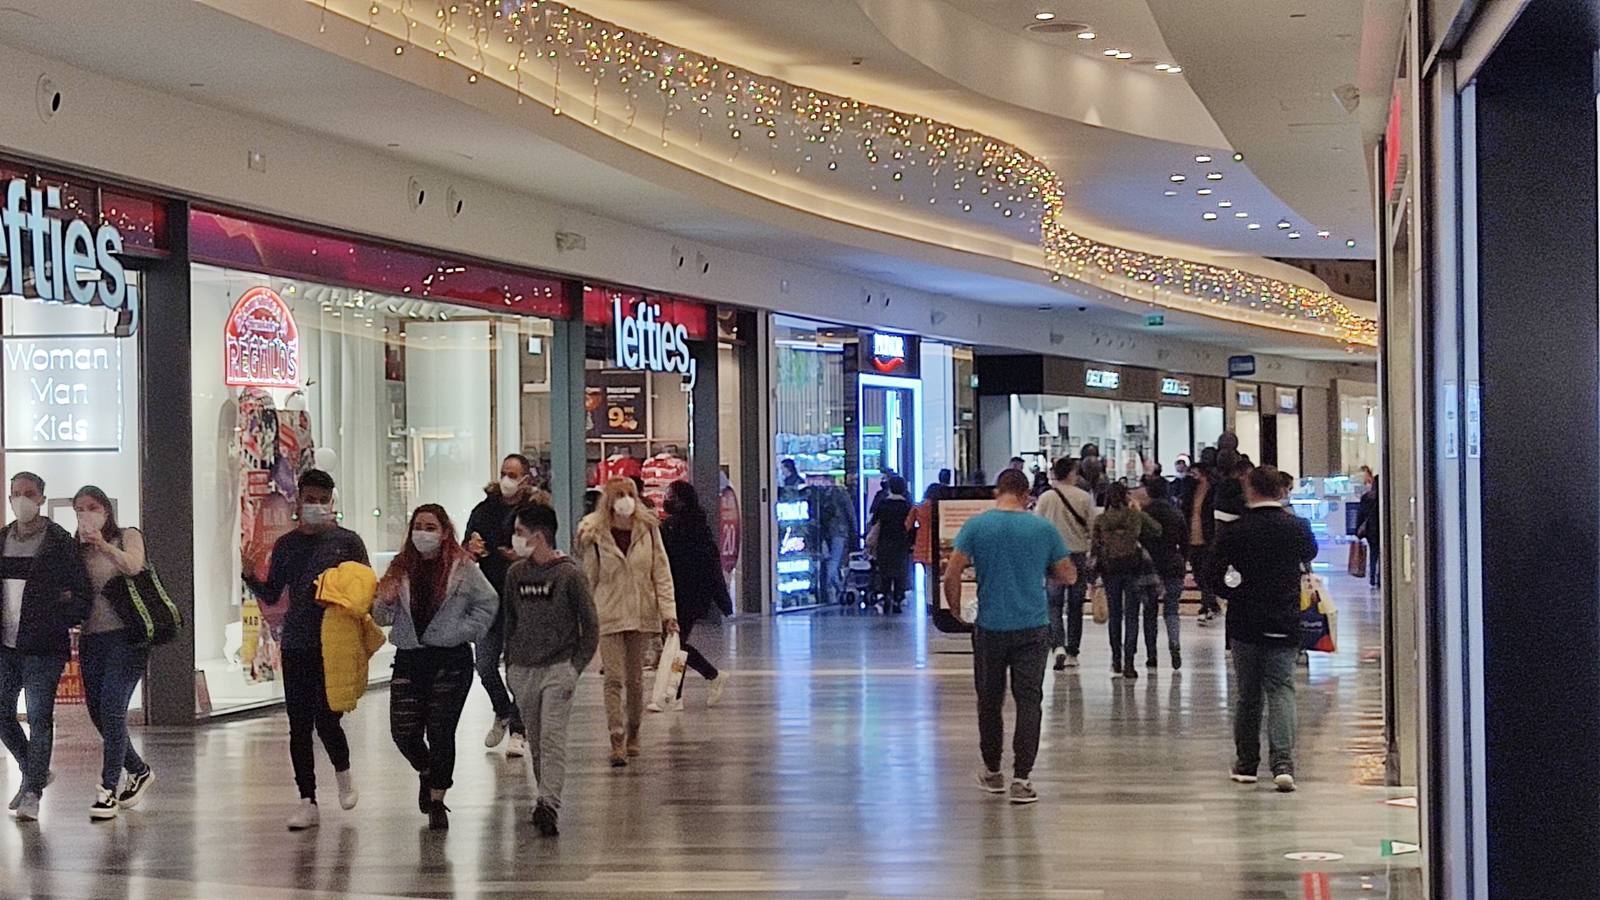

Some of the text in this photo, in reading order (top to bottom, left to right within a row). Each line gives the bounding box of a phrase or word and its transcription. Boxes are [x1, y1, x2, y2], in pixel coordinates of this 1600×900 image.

[0, 178, 138, 337] fties,
[4, 343, 108, 371] Woman
[31, 377, 88, 405] Man
[33, 414, 88, 442] Kids
